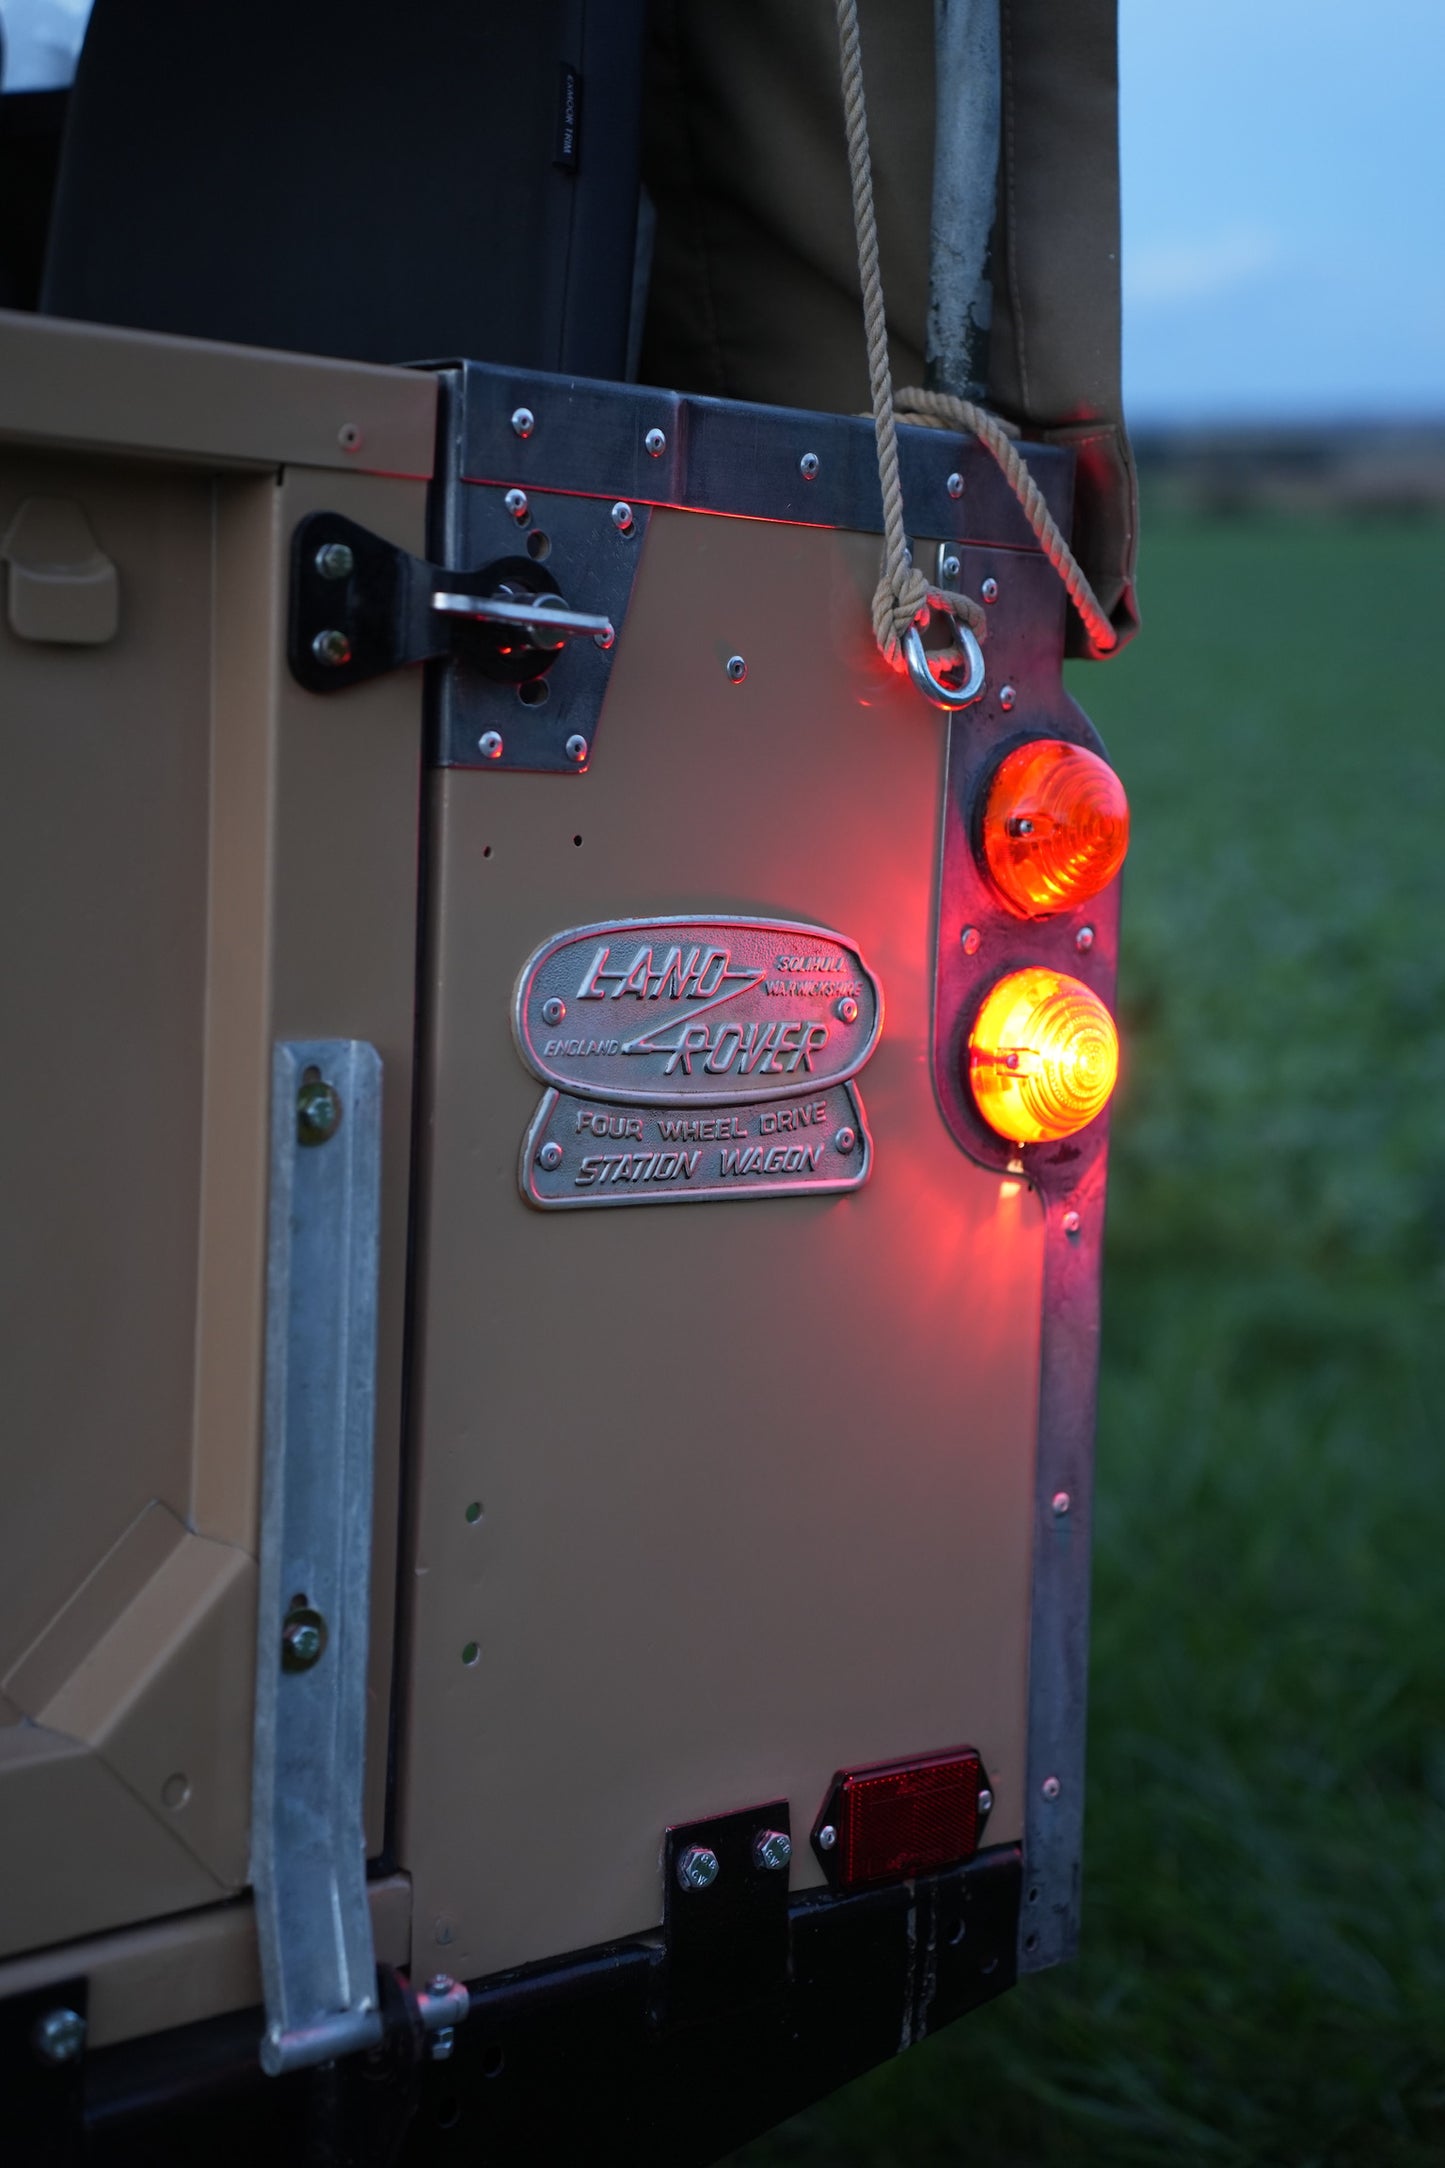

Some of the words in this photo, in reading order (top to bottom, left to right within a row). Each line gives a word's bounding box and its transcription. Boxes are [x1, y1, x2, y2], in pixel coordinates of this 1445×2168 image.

[563, 128, 573, 153] TRIM
[576, 946, 731, 1000] LAND
[777, 956, 847, 972] SOLIHULL
[765, 980, 863, 997] WARWICKSHIRE
[545, 1039, 620, 1057] ENGLAND
[664, 1021, 829, 1075] ROVER
[576, 1111, 644, 1141] FOUR
[657, 1117, 748, 1142] WHEEL
[760, 1101, 827, 1136] DRIVE
[575, 1150, 702, 1186] STATION
[719, 1145, 826, 1179] WAGON
